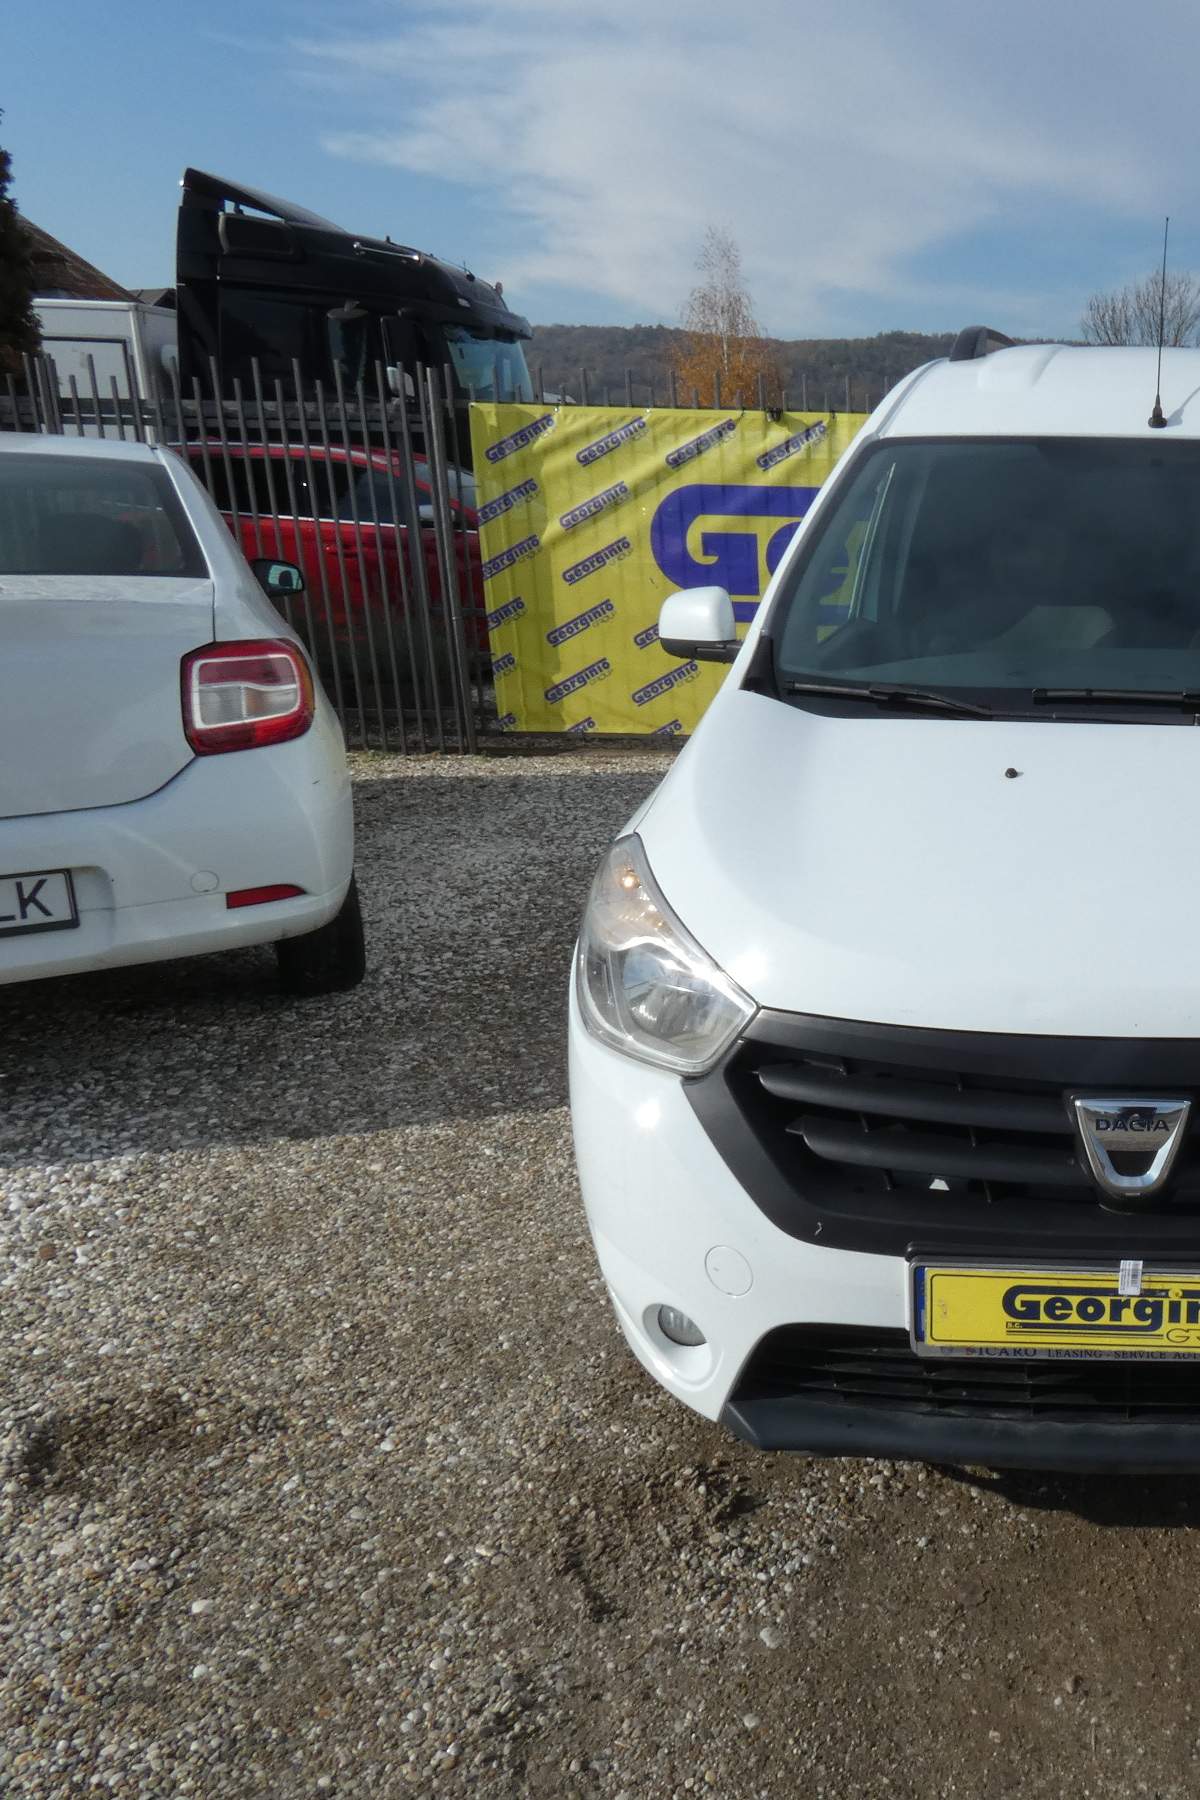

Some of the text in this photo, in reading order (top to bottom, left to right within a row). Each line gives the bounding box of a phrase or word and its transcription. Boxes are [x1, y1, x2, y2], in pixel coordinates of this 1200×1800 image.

[576, 416, 646, 467] Georginio
[560, 480, 628, 531] Georginio
[562, 536, 631, 586] Georginio
[546, 599, 614, 648] Georginio
[544, 657, 611, 705] Georginio
[632, 660, 699, 707] Georginio
[0, 878, 54, 920] K
[1095, 1119, 1170, 1132] DACIA
